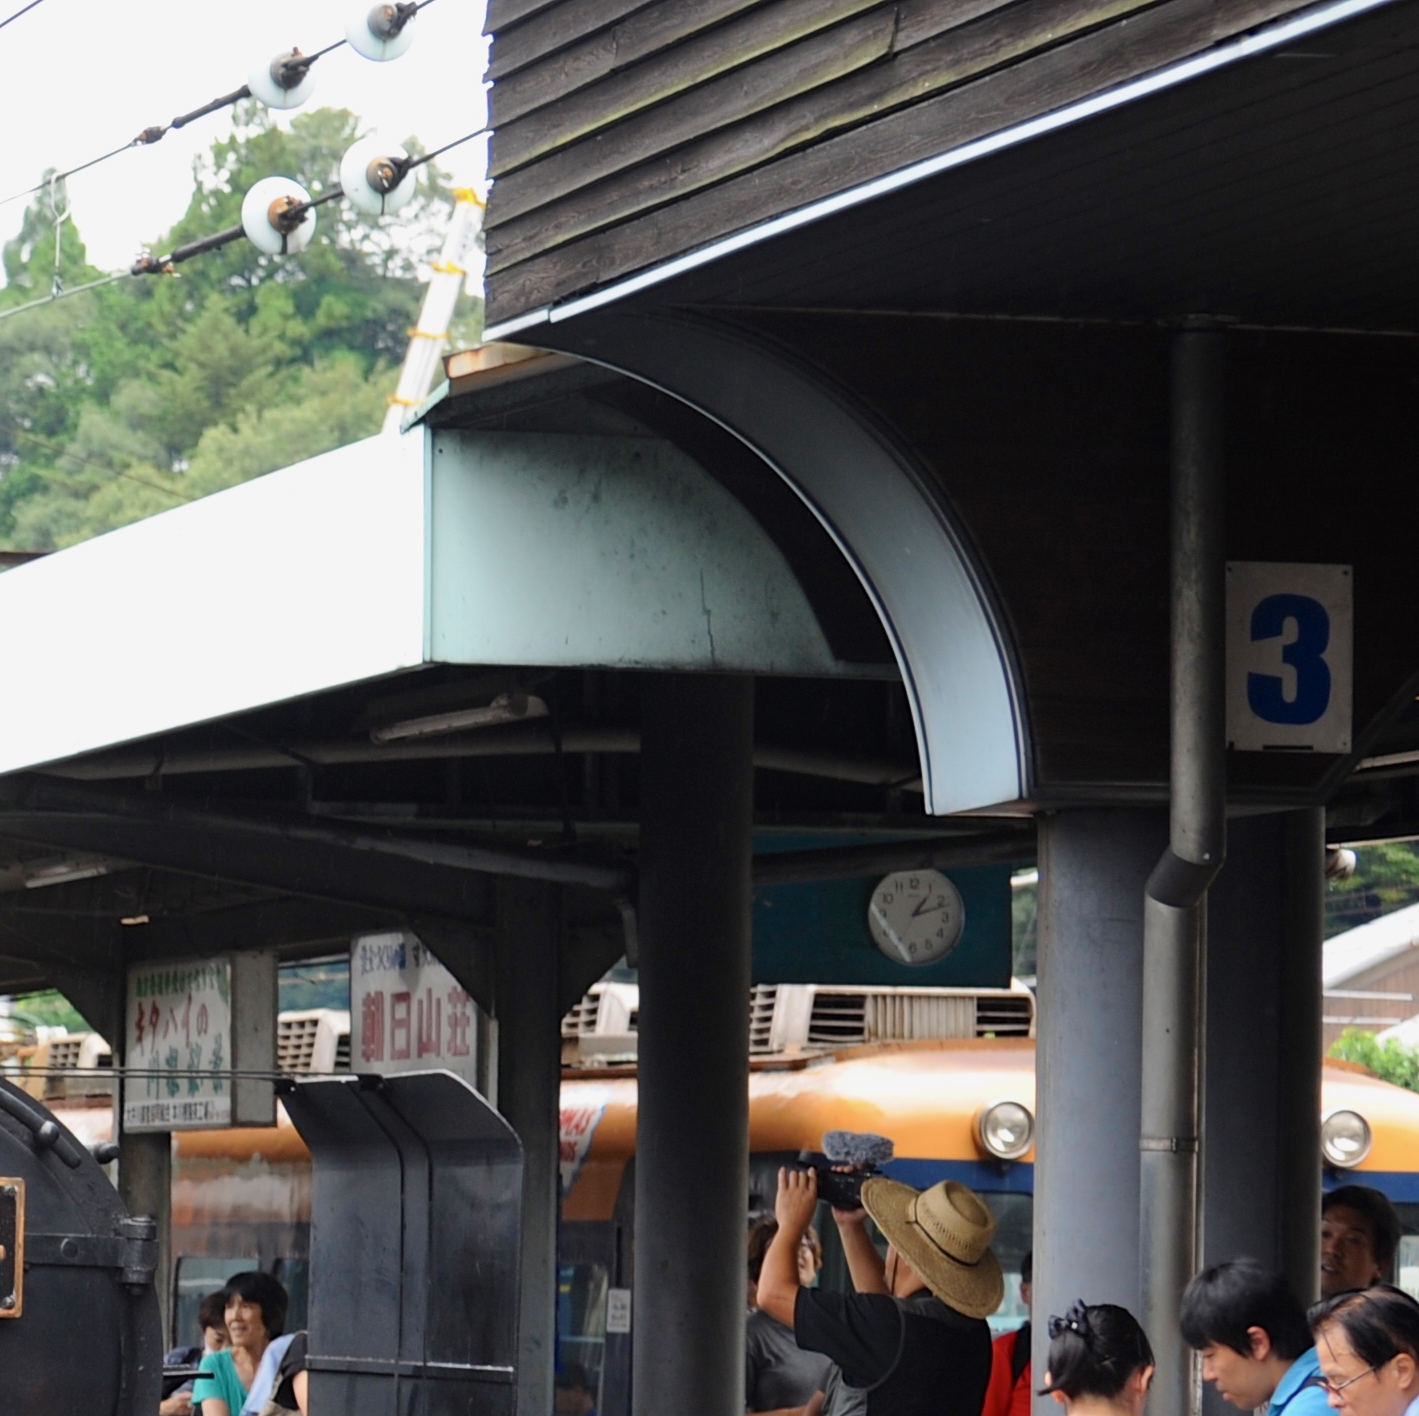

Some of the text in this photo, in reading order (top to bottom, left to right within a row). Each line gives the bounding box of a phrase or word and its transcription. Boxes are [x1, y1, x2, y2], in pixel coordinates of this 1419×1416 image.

[1246, 593, 1332, 726] 3
[909, 878, 920, 889] 12
[361, 986, 470, 1063] 朝日山荘
